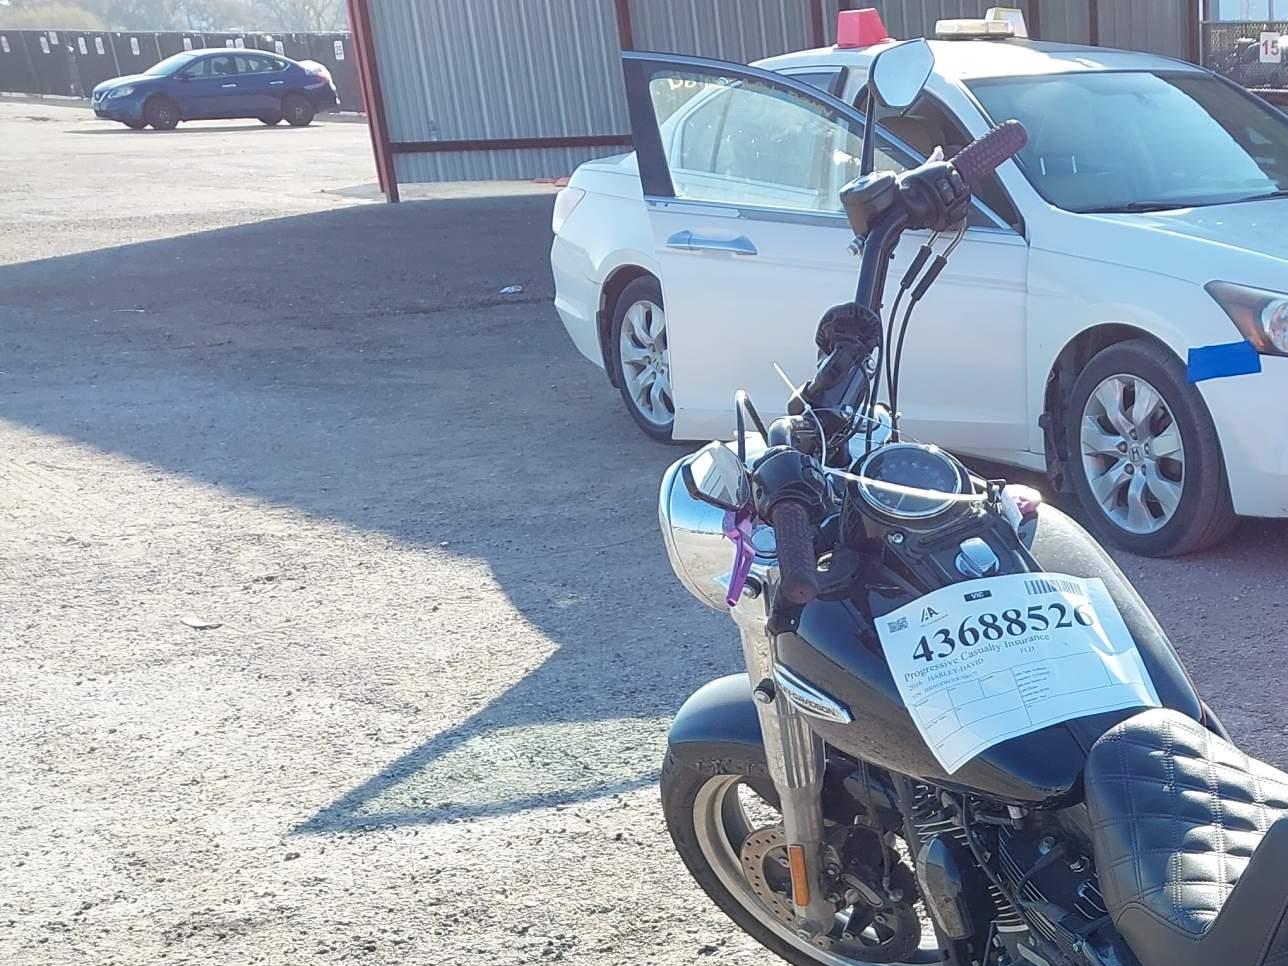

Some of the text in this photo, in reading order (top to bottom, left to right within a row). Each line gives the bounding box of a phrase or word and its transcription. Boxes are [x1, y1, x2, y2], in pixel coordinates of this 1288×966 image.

[1261, 39, 1280, 56] 15
[912, 602, 1094, 662] 43688526
[904, 657, 958, 682] Progressive
[960, 642, 1002, 661] Casualty
[1004, 633, 1050, 649] Insurance
